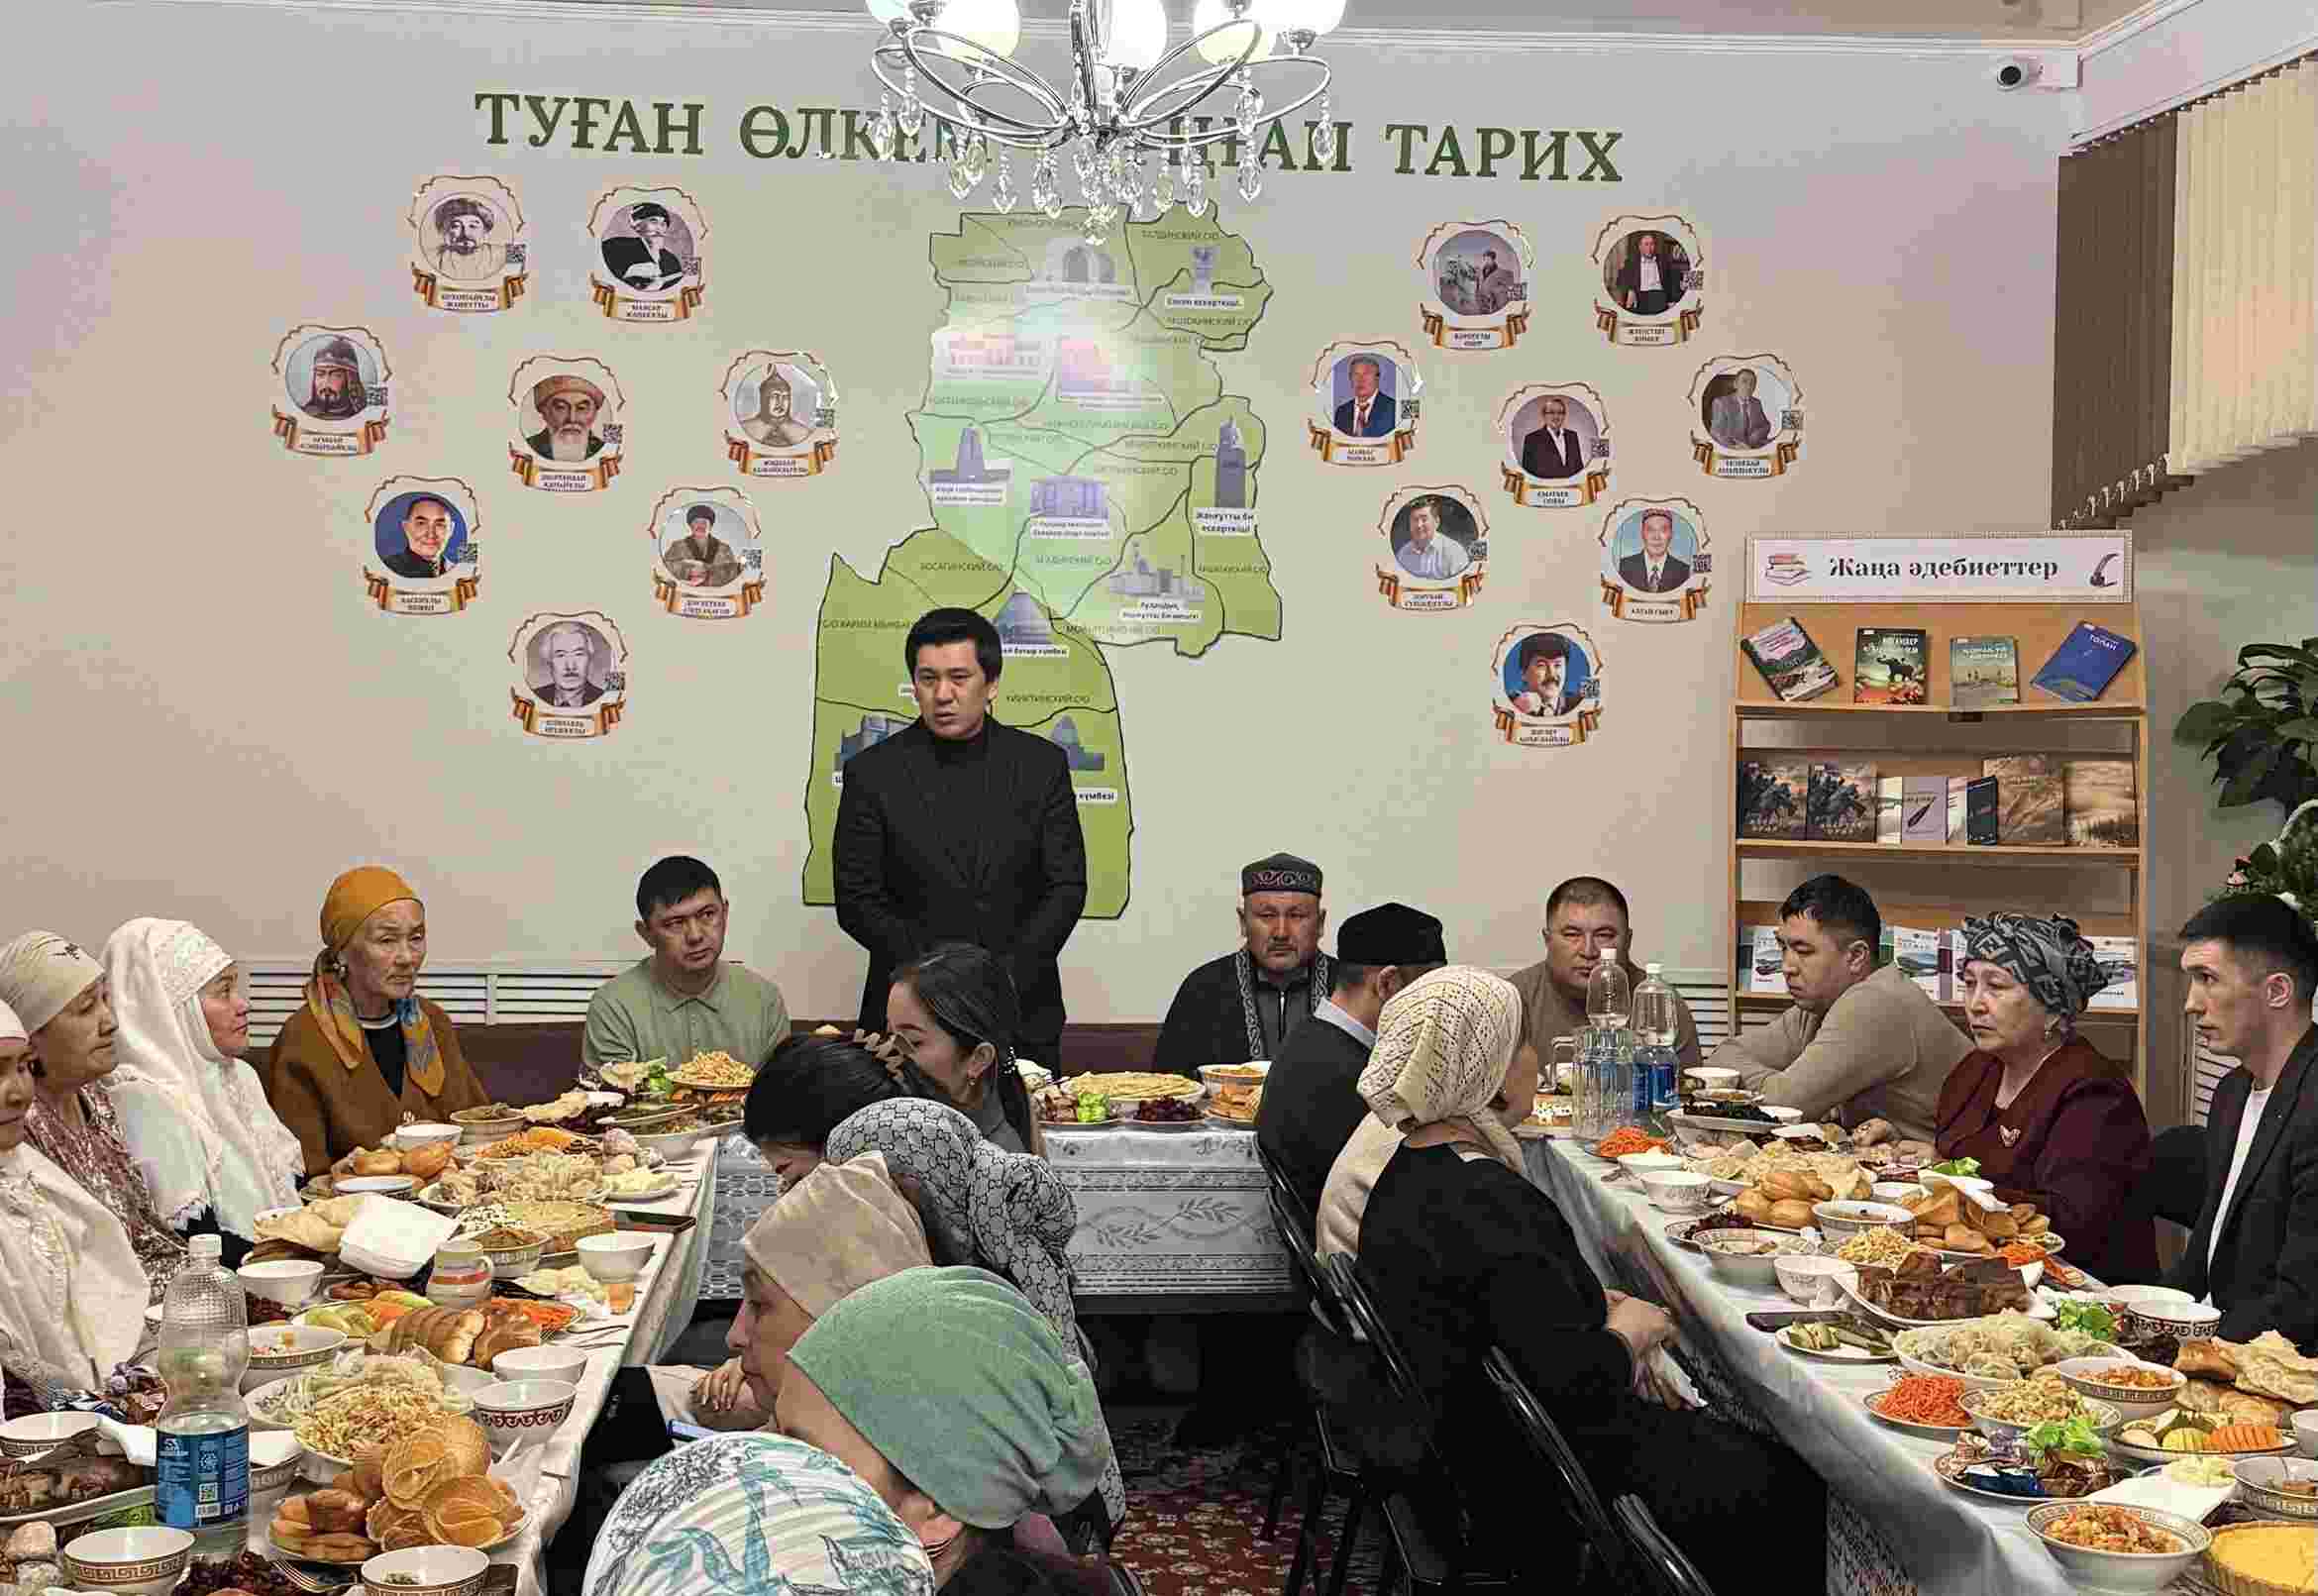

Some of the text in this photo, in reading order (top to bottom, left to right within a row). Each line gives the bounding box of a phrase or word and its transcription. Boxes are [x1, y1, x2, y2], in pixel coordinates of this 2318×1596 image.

[474, 93, 704, 155] ТУҒАН
[1384, 123, 1625, 182] ТАРИХ
[1830, 558, 2058, 581] Жаңа әдебиеттер
